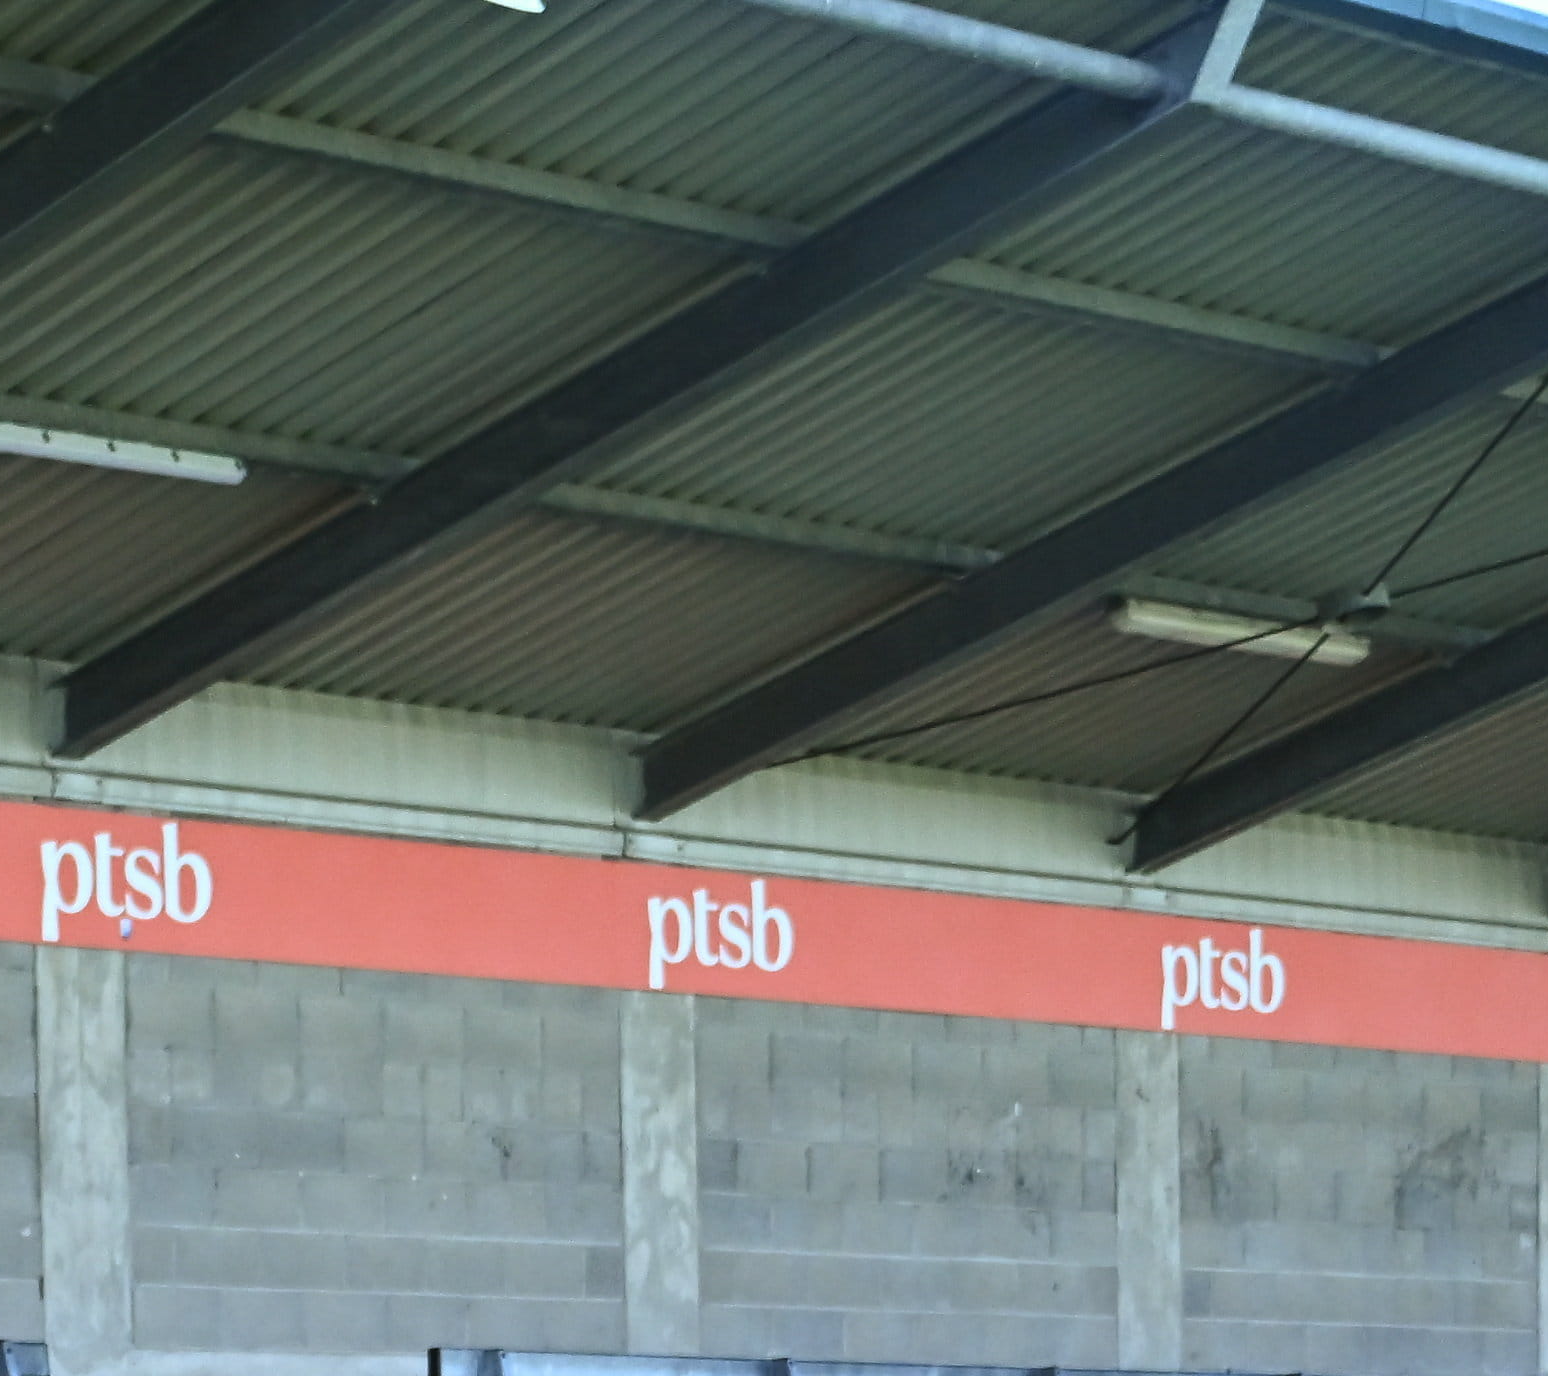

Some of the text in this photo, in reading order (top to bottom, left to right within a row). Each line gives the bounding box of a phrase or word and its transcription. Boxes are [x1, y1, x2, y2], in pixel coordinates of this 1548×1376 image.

[40, 822, 213, 942] ptsb
[647, 878, 795, 991] ptsb
[1161, 929, 1286, 1030] ptsb
